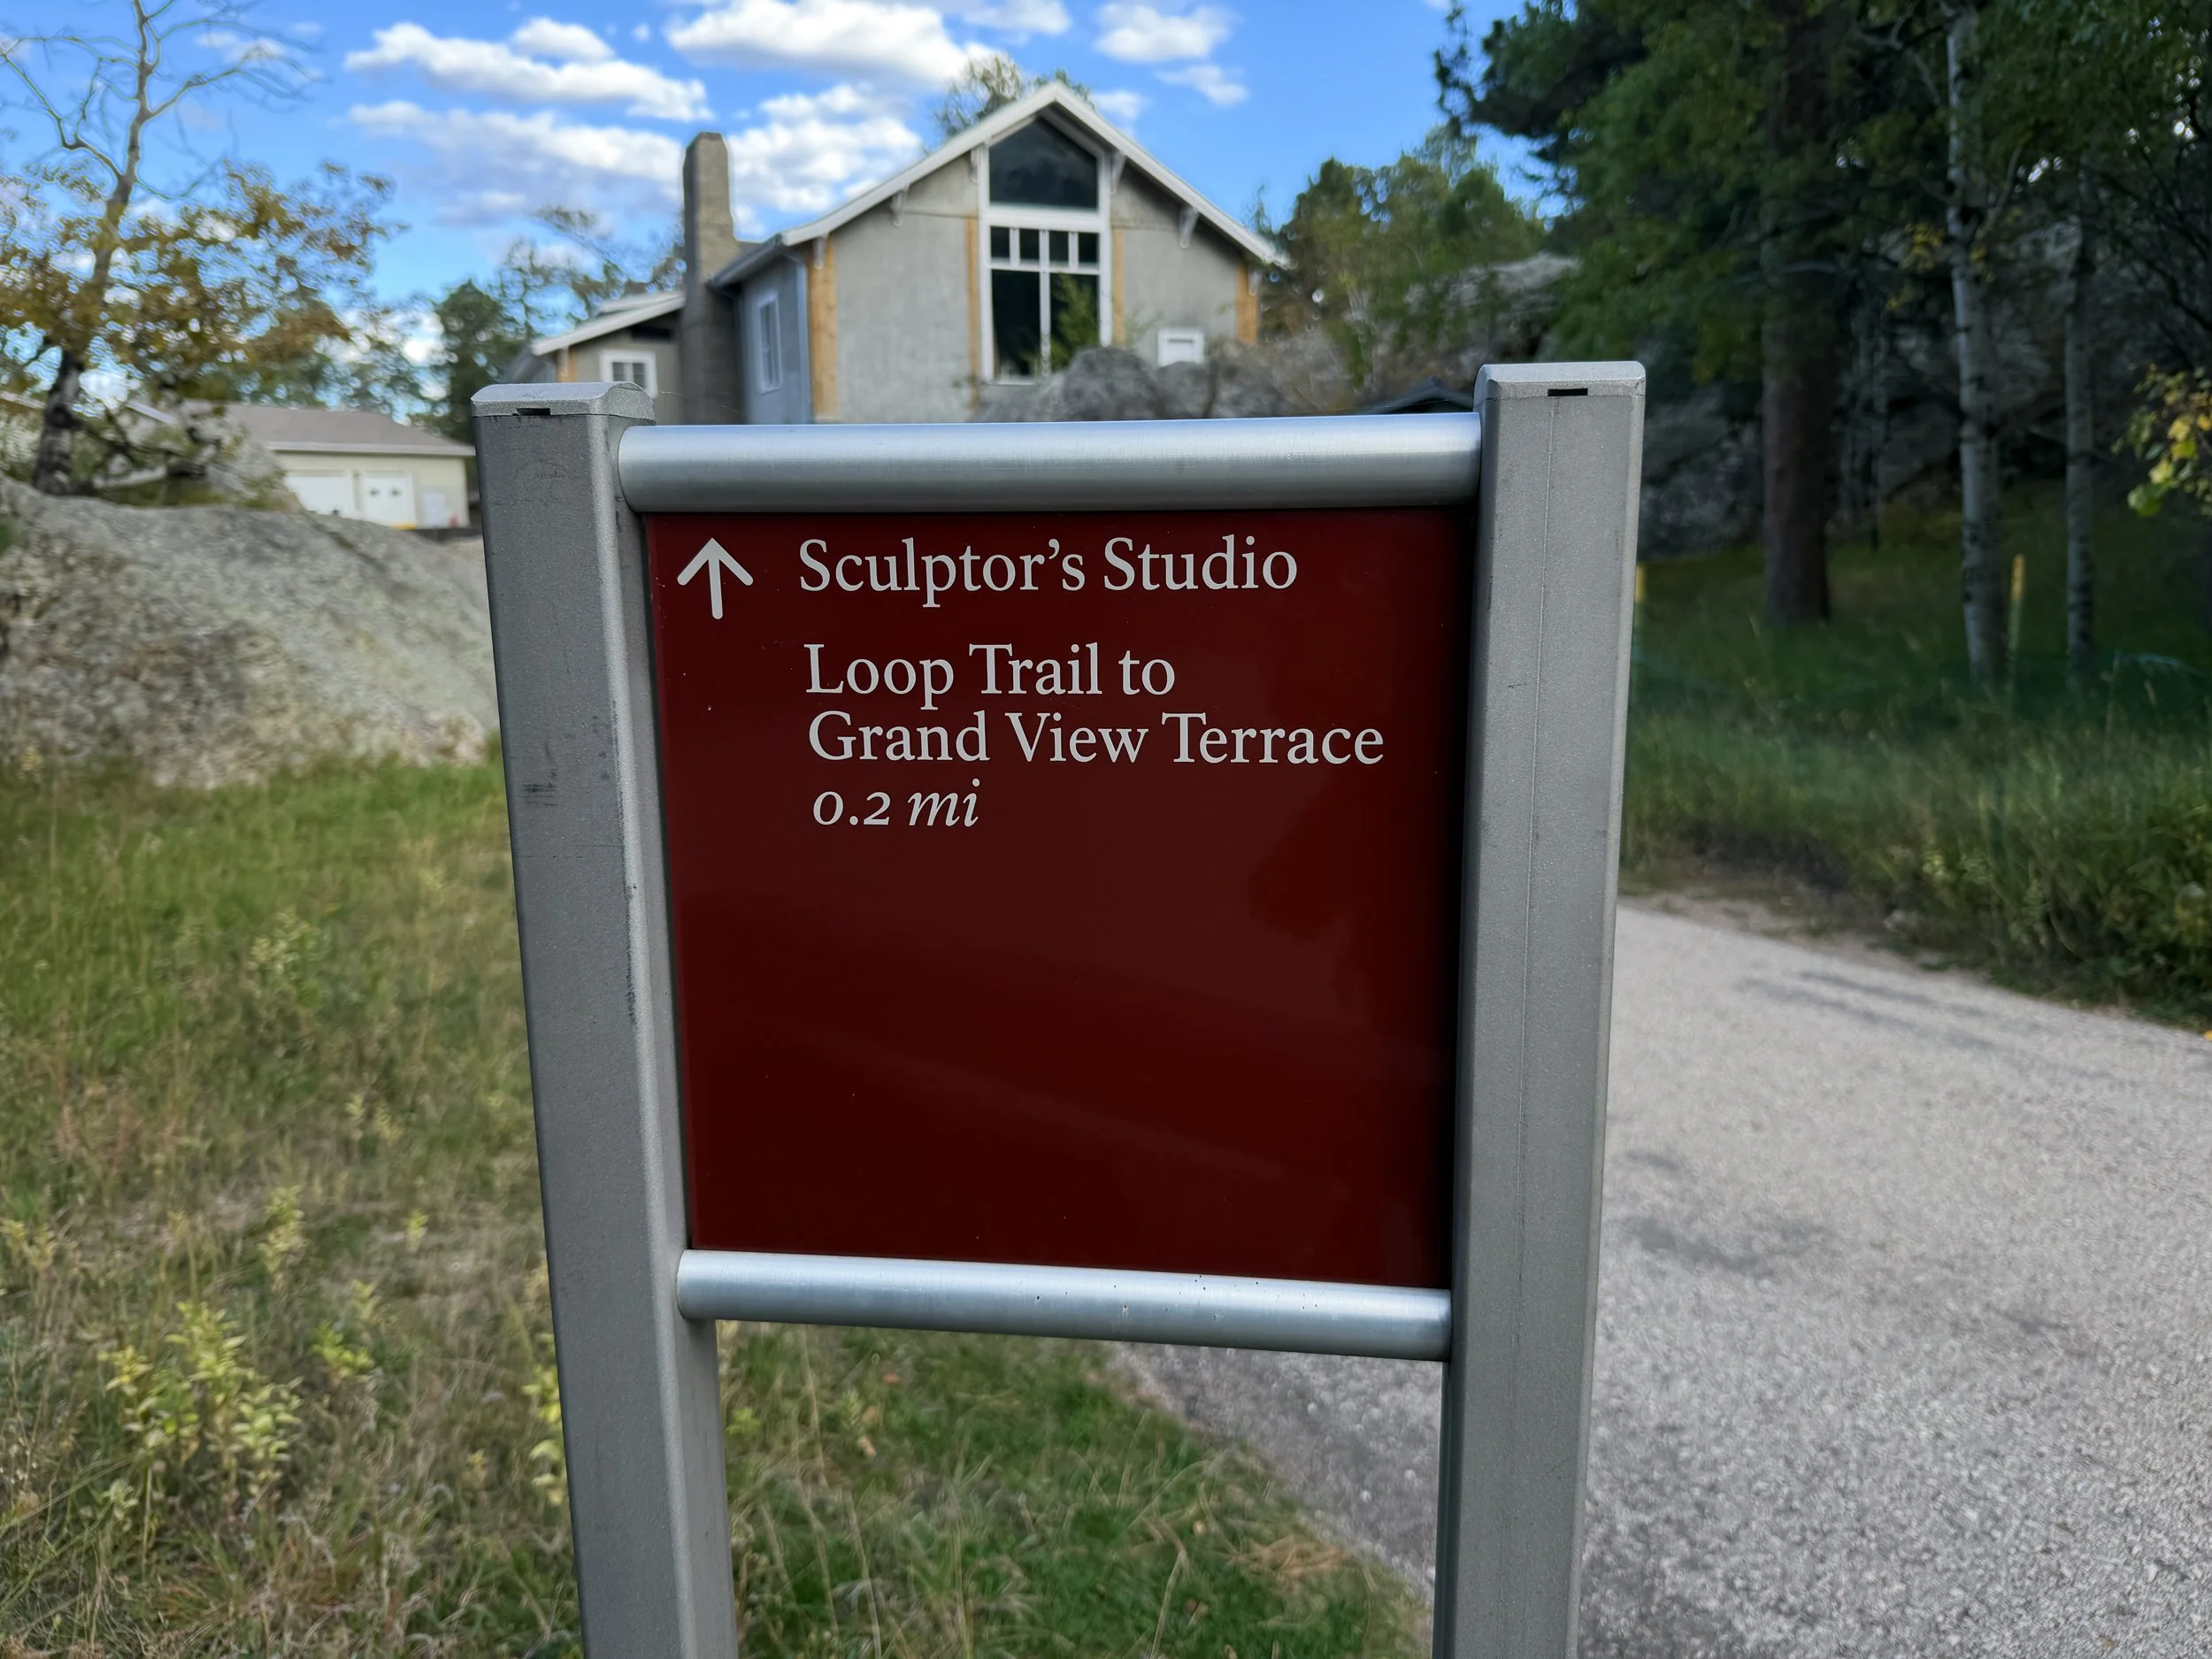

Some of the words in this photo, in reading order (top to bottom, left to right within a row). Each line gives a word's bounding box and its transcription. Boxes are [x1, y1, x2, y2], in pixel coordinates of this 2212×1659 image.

[1103, 534, 1298, 592] Studio
[803, 642, 955, 711] Loop
[968, 641, 1103, 696] Trail
[1118, 649, 1176, 696] to
[809, 710, 992, 762] Grand
[1004, 711, 1149, 764] View
[1161, 711, 1385, 765] Terrace
[812, 790, 892, 826] 0.2
[907, 778, 981, 828] mi
